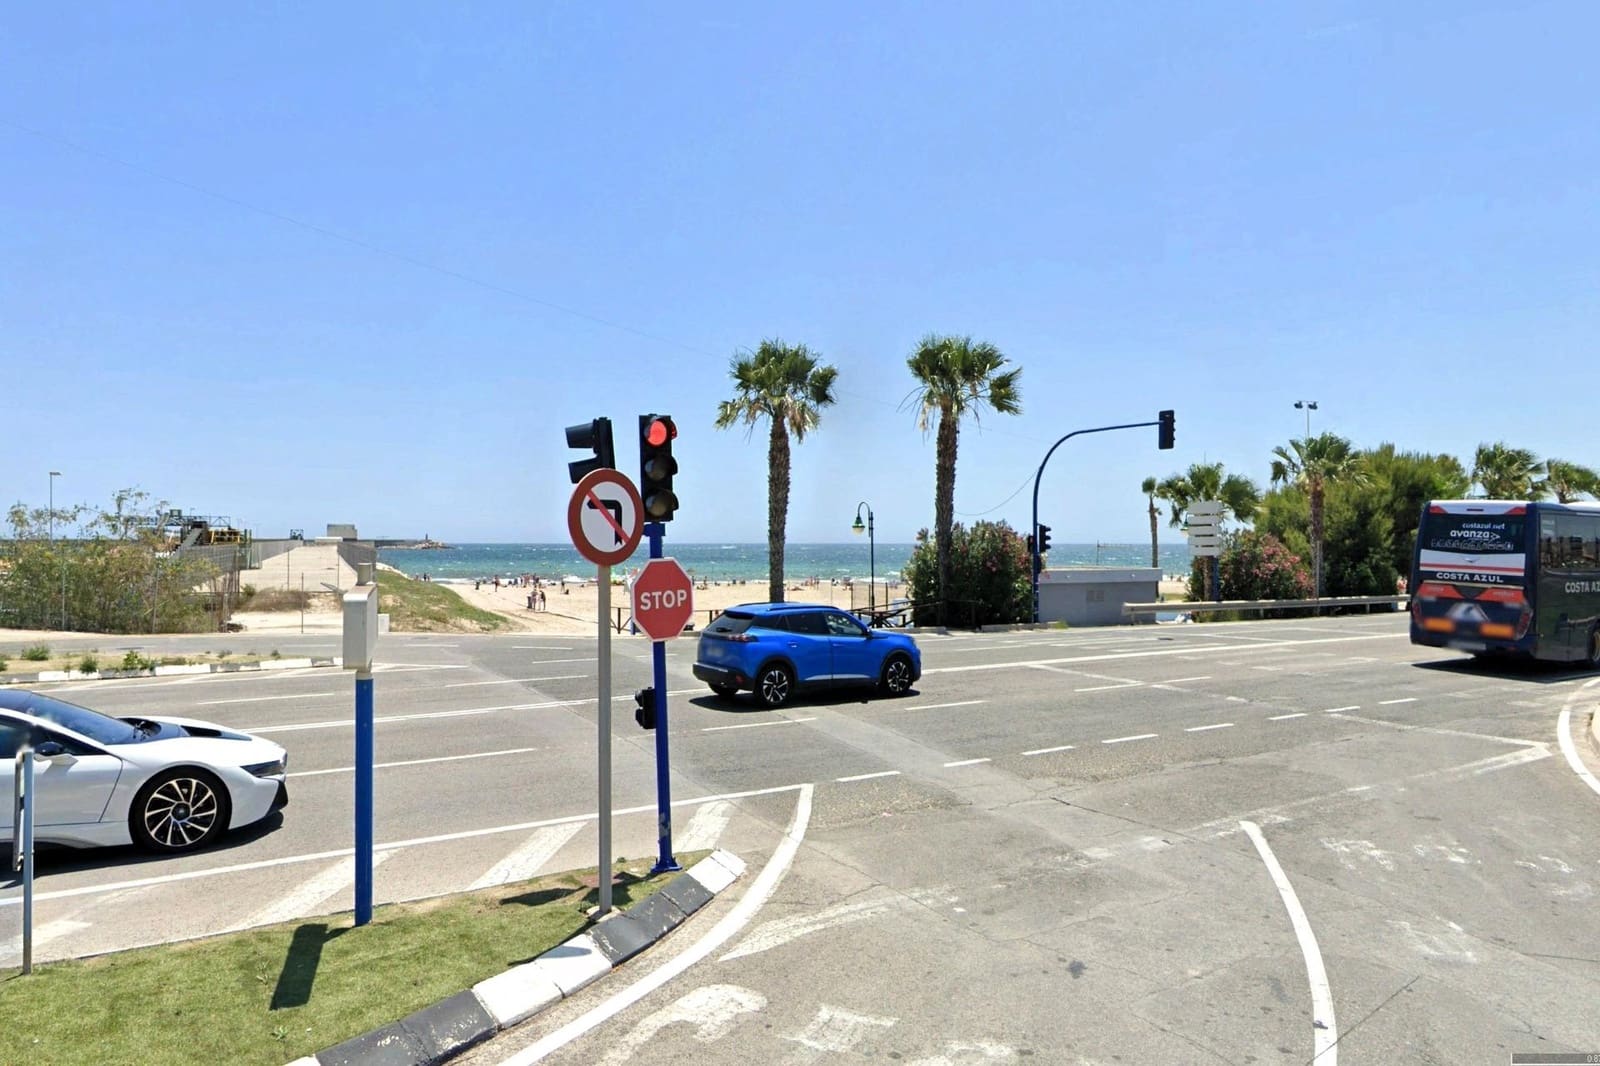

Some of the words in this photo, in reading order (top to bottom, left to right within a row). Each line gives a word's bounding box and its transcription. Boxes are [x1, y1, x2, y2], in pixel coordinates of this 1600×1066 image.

[1450, 530, 1490, 539] avanza
[1436, 572, 1470, 581] COSTA
[1473, 574, 1504, 583] AZUL
[1565, 581, 1590, 593] COSTA
[640, 589, 688, 611] STOP
